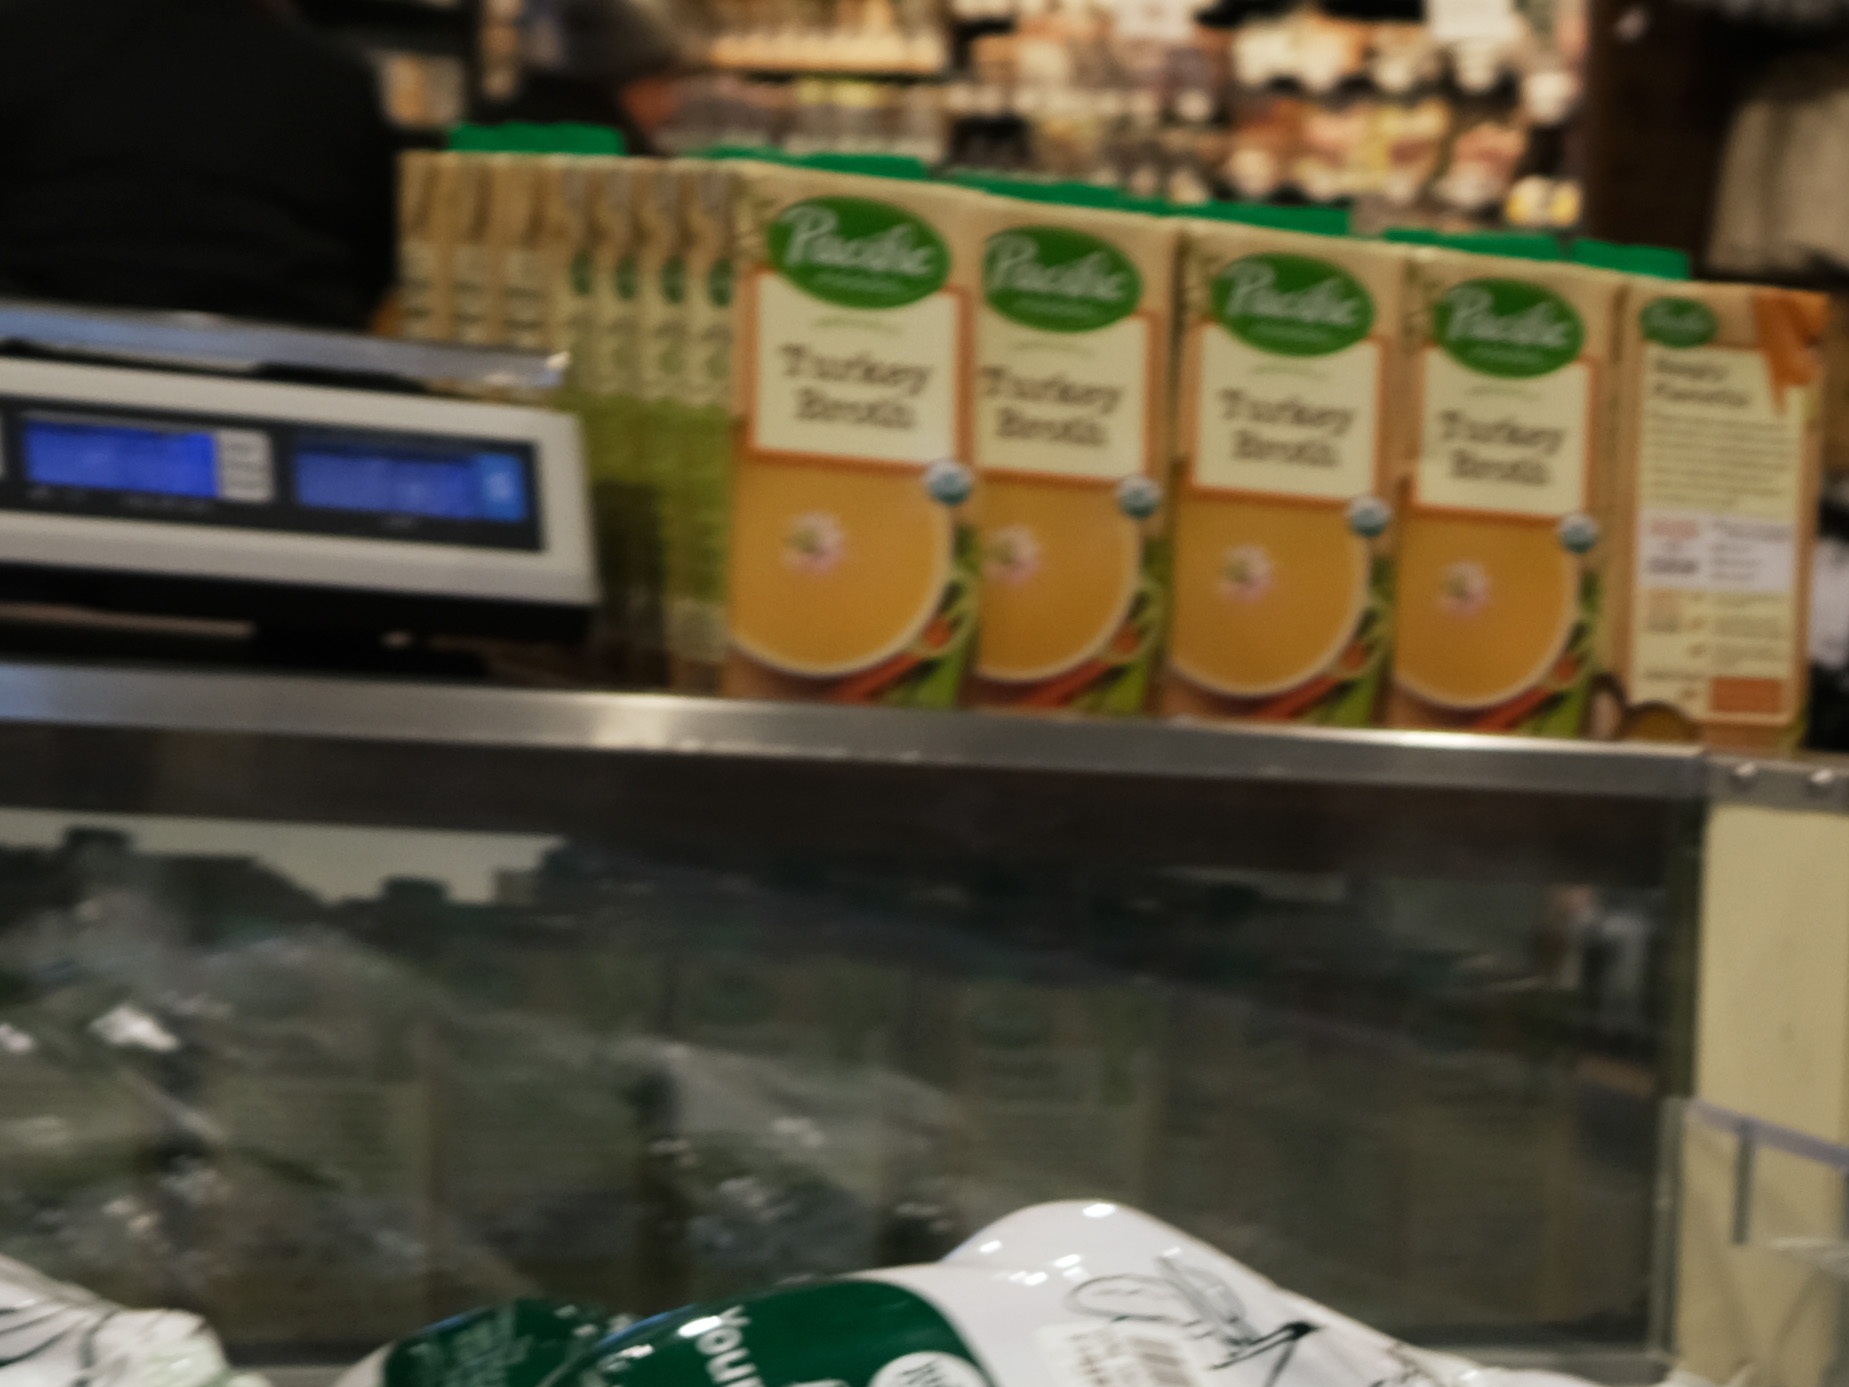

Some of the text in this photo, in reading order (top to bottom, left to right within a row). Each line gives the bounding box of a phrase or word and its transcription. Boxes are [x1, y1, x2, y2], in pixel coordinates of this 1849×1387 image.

[780, 345, 932, 395] Turkey
[979, 366, 1122, 415] Turkey
[1218, 388, 1353, 436] Turkey
[1440, 409, 1564, 456] Turkey
